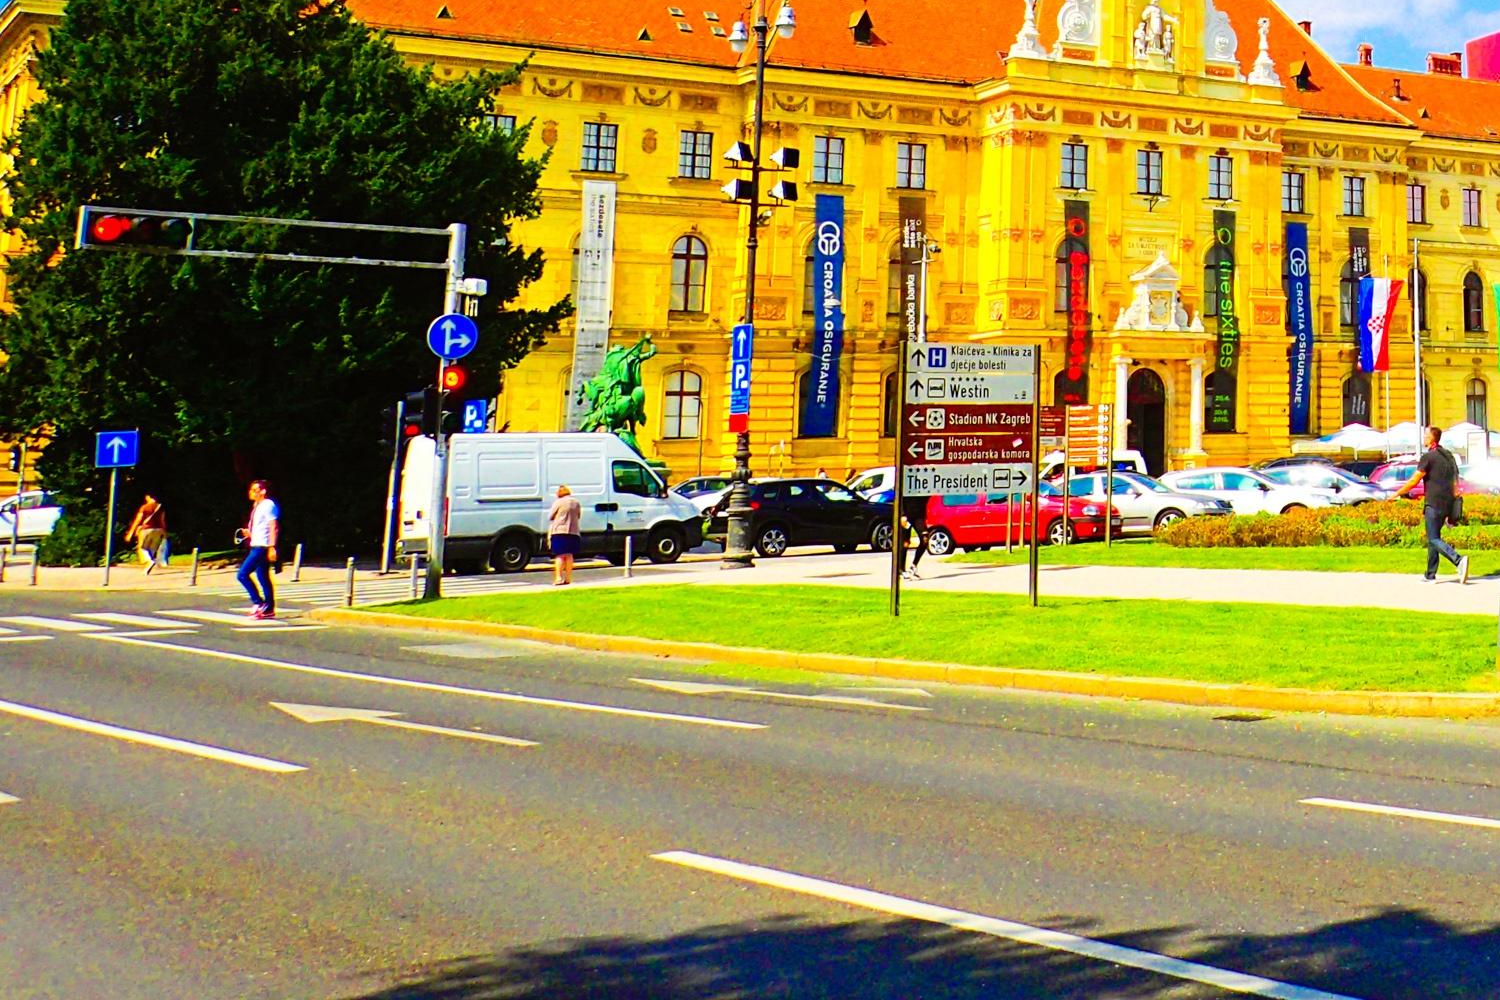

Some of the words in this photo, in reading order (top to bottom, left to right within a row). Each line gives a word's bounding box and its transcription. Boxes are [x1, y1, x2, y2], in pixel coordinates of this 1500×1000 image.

[1219, 259, 1233, 294] the
[906, 274, 916, 300] banka
[1295, 281, 1306, 330] CROATIA
[1219, 299, 1238, 369] sixties
[932, 350, 943, 366] H
[951, 345, 985, 356] Klaićeva
[993, 346, 1020, 357] Klinika
[1022, 349, 1032, 357] za
[816, 320, 835, 403] OSIGURANJE
[950, 360, 976, 372] dječje
[978, 360, 1006, 370] bolesti
[1294, 332, 1307, 403] OSIGURANJE
[735, 364, 746, 389] P
[950, 384, 990, 398] Westin
[465, 405, 477, 426] P
[949, 413, 983, 425] Stadion
[985, 413, 998, 425] NK
[1000, 412, 1031, 426] Zagreb
[948, 436, 983, 447] Hrvatska
[948, 449, 999, 462] gospodarska
[1001, 448, 1030, 459] komora
[907, 475, 928, 489] The
[933, 474, 988, 489] President
